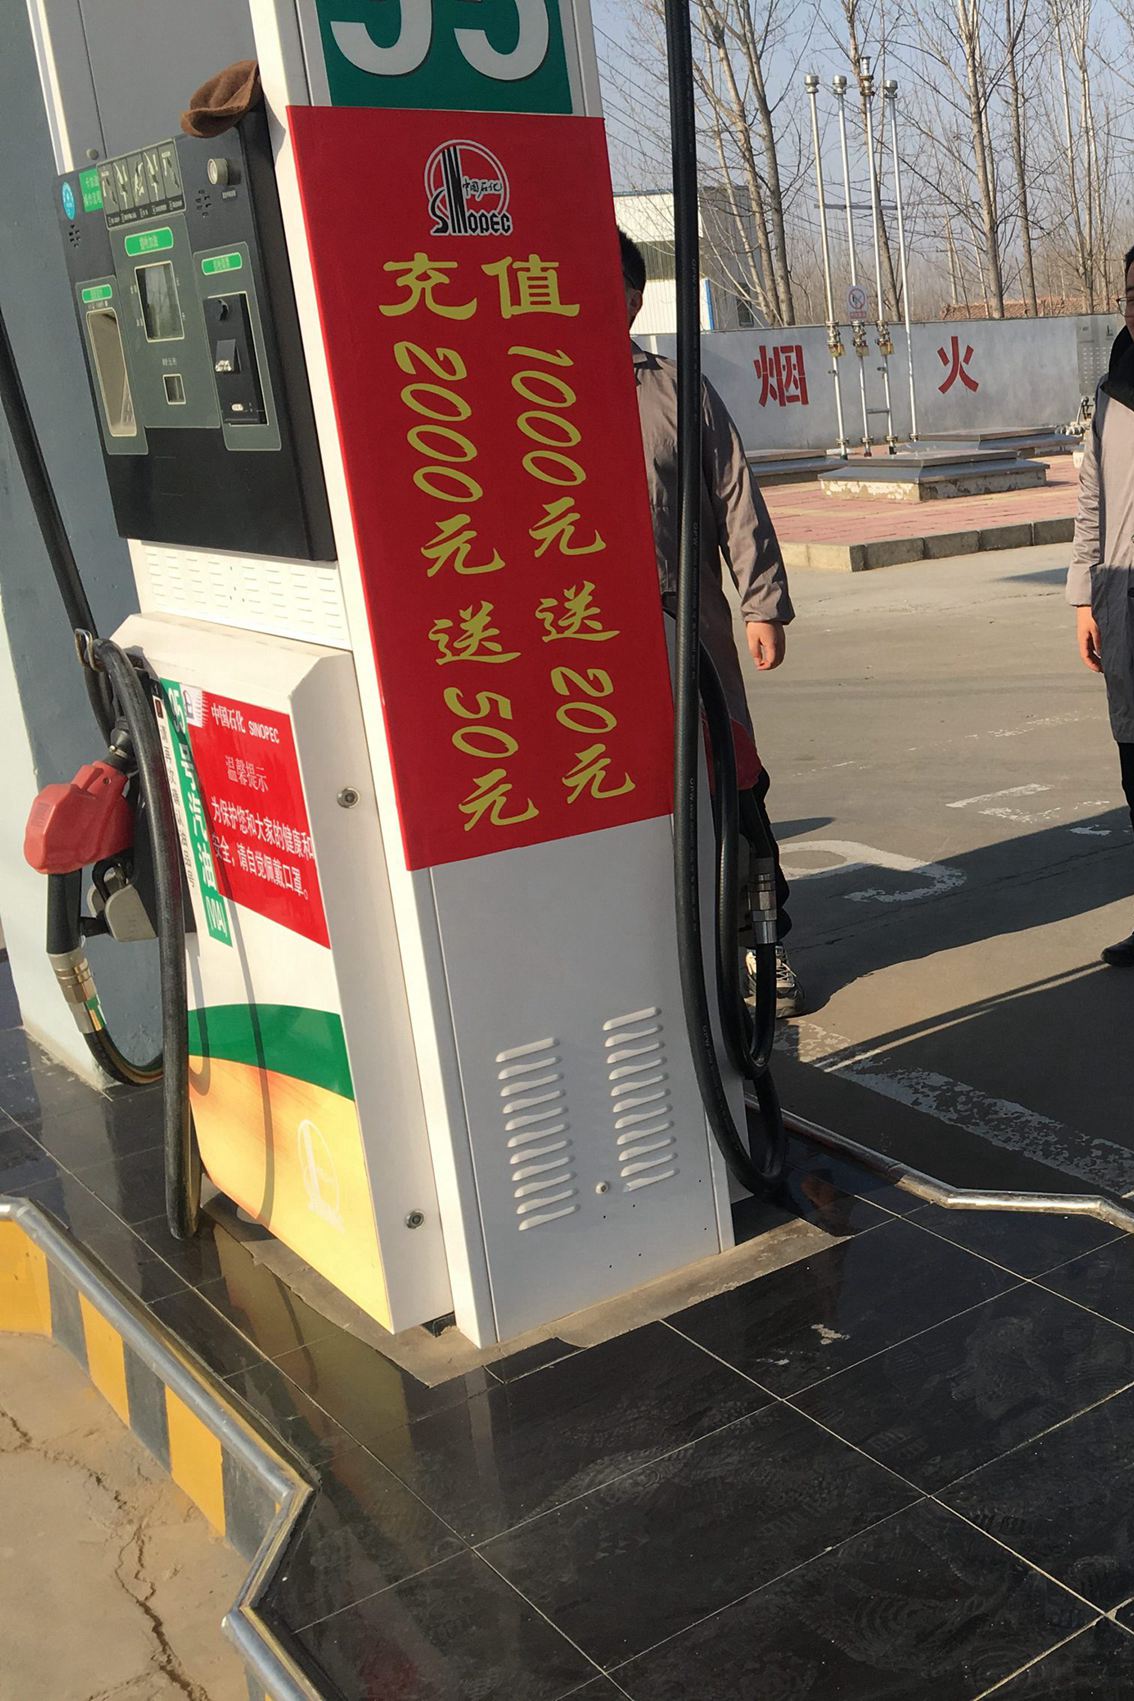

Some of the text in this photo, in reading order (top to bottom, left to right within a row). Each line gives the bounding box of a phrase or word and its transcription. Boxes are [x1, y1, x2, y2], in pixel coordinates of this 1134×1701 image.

[378, 252, 580, 320] 充值
[211, 702, 280, 744] 中国石化 SINOPEC
[225, 755, 269, 793] 温馨提示
